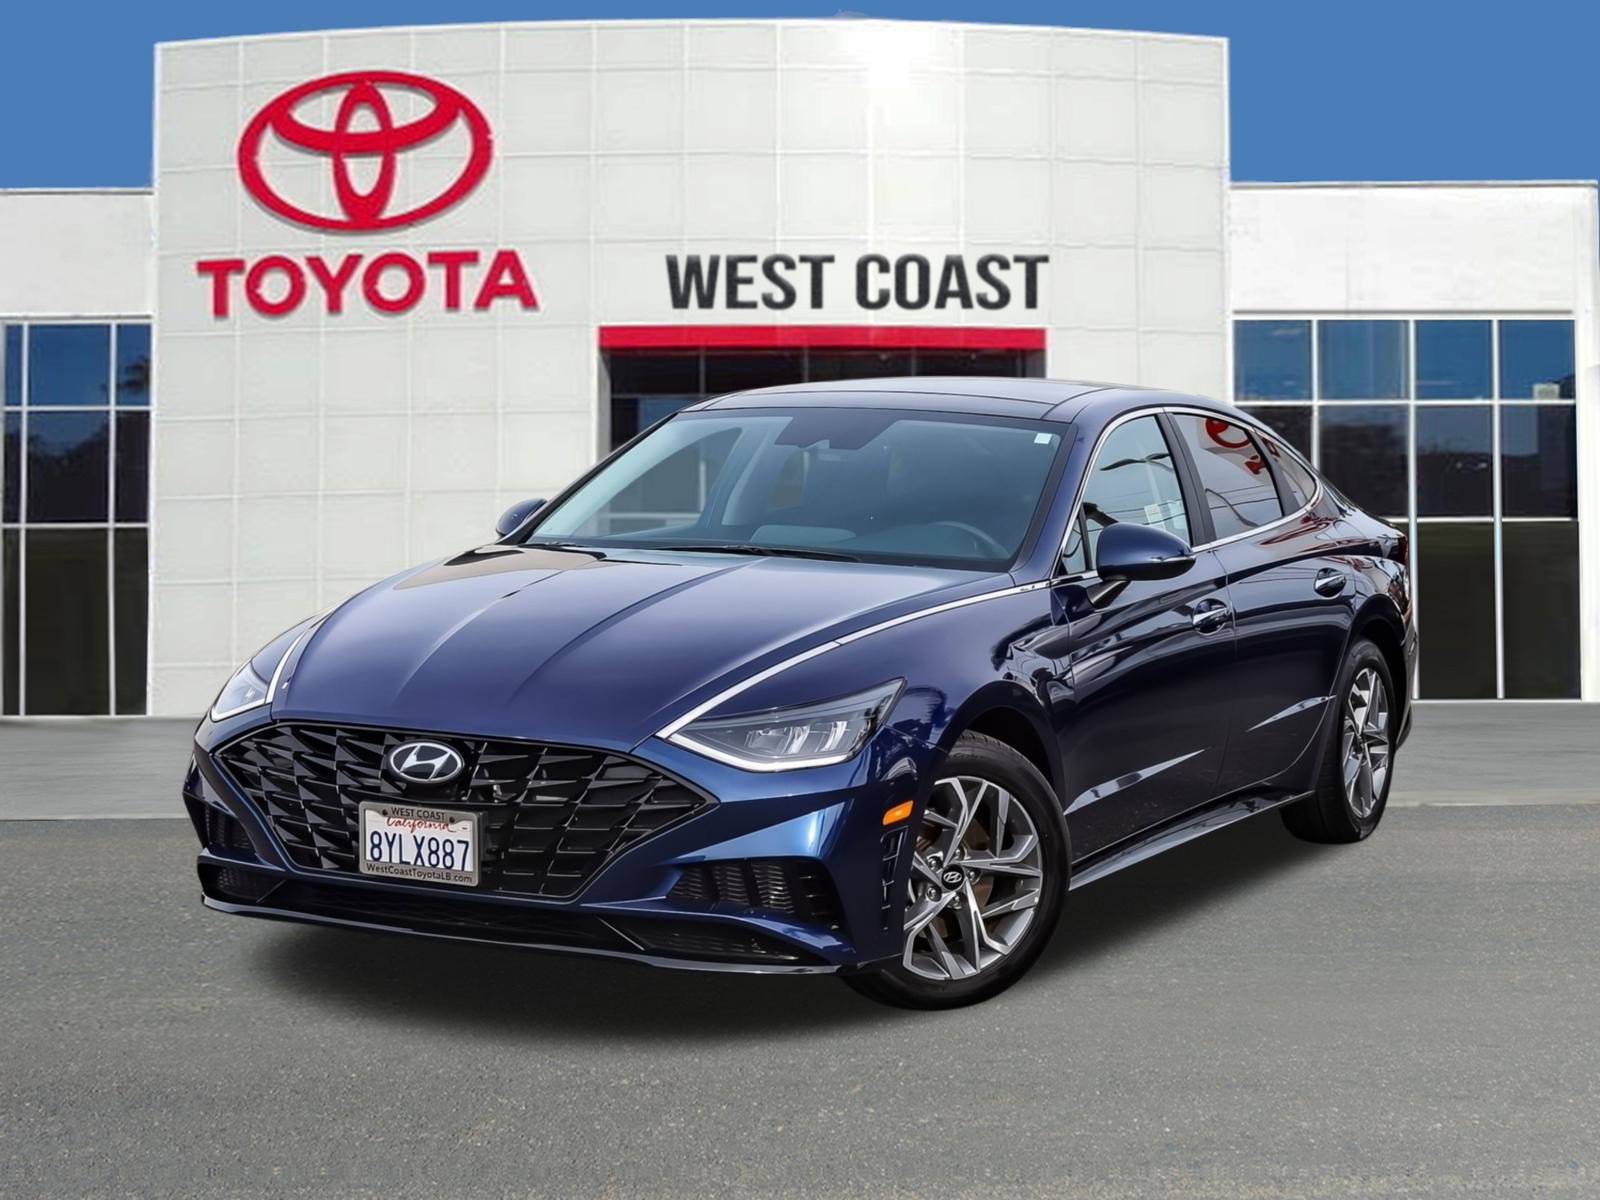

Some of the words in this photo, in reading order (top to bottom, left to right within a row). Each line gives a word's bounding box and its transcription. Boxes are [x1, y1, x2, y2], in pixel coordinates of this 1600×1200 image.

[196, 249, 540, 318] TOYOTA
[665, 254, 835, 309] WEST
[855, 254, 1049, 309] COAST
[391, 807, 414, 818] WEST
[416, 809, 446, 821] COAST
[370, 830, 469, 871] 8YLX887
[366, 863, 472, 883] WestCoastToyotaLB.com
